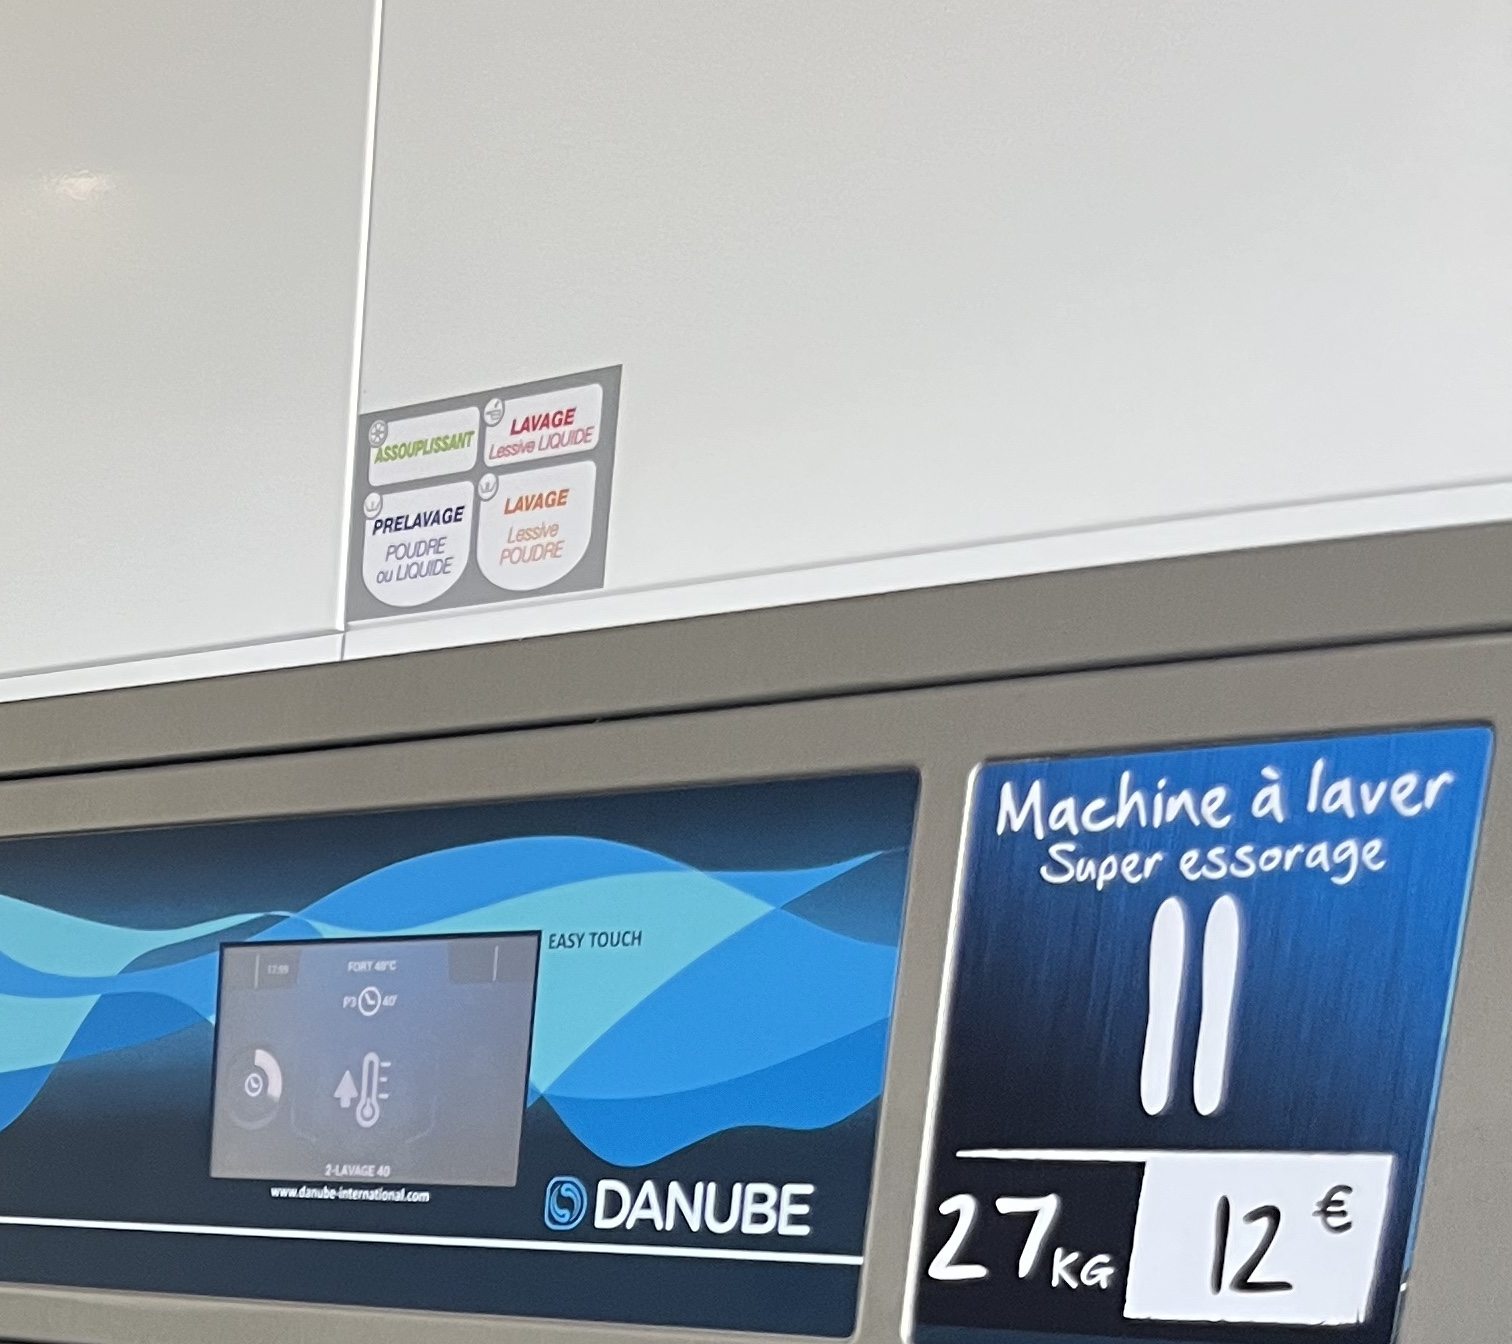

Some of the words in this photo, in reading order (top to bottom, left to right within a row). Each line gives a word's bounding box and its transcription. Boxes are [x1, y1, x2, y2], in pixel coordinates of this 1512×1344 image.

[510, 407, 577, 436] LAVAGE
[374, 430, 475, 465] ASSOUPLISSANT
[488, 439, 535, 460] Lessive
[537, 425, 596, 452] LIQUIDE
[503, 488, 570, 515] LAVAGE
[372, 505, 465, 536] PRELAVAGE
[507, 522, 559, 544] Lessive
[385, 536, 448, 563] POUDRE
[499, 540, 565, 566] POUDRE
[376, 570, 394, 584] ou
[395, 556, 455, 582] LIQUIDE
[995, 769, 1232, 841] Machine
[1251, 765, 1286, 823] à
[1306, 756, 1457, 819] laver
[1039, 841, 1164, 891] Super
[1179, 837, 1387, 886] essorage
[548, 932, 585, 950] EASY
[588, 930, 643, 949] TOUCH
[1139, 895, 1240, 1117] 11
[270, 1185, 430, 1202] www.danube-international.com
[593, 1179, 816, 1237] DANUBE
